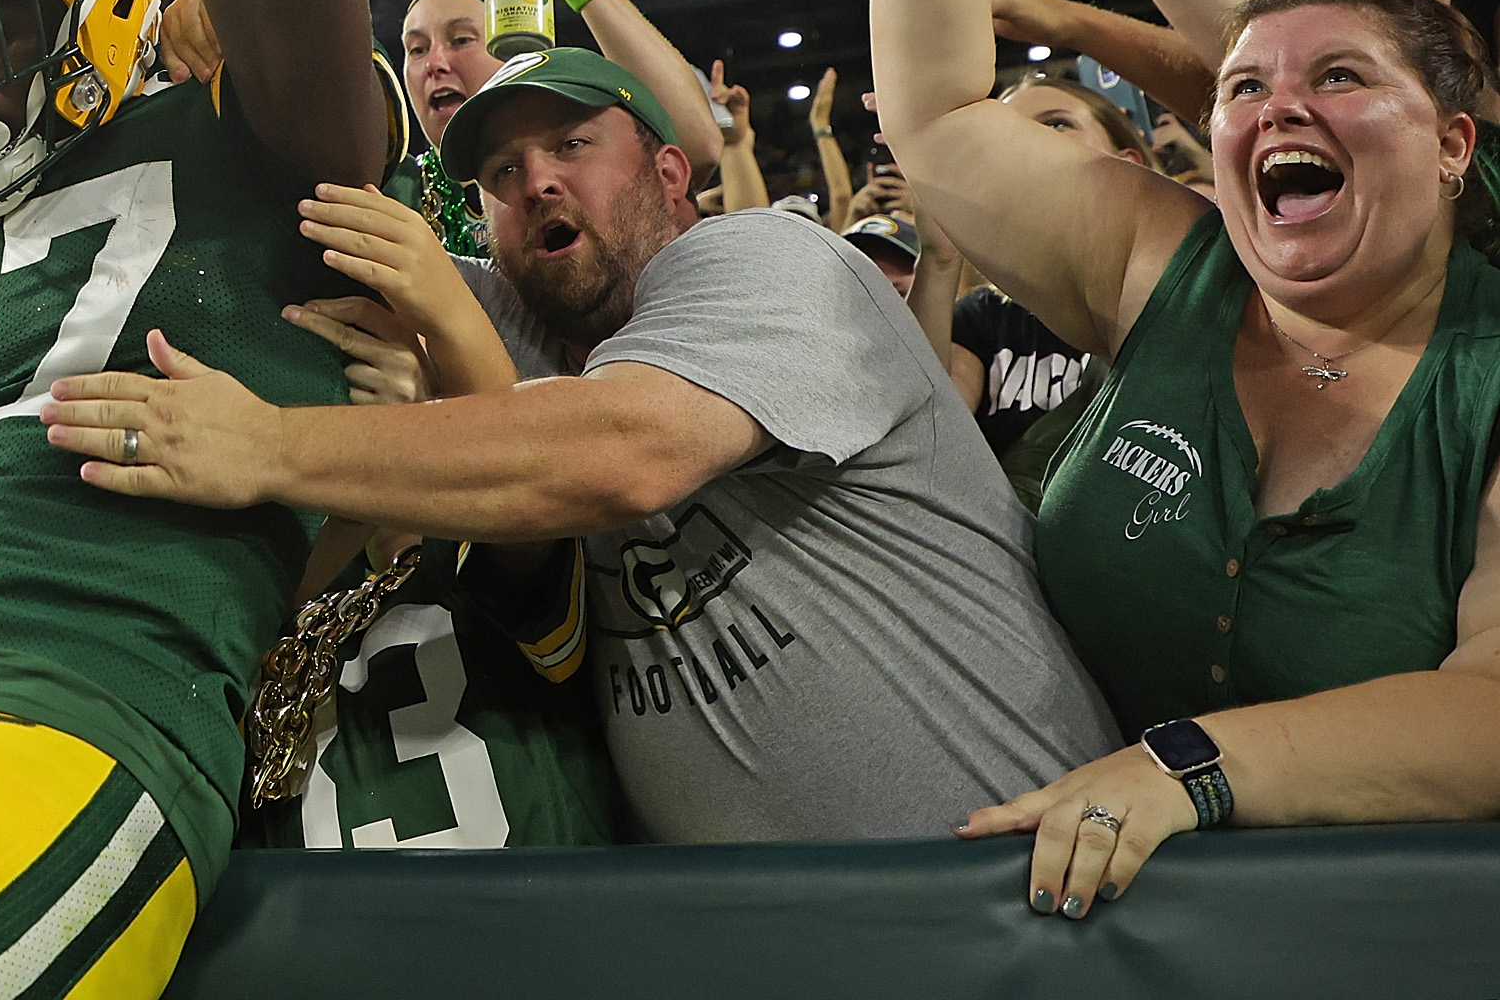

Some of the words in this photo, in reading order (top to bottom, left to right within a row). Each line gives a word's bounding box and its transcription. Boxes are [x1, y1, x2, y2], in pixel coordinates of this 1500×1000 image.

[1101, 435, 1192, 497] PACKERS
[1124, 489, 1192, 540] Girl
[609, 604, 795, 716] FOOTBALL
